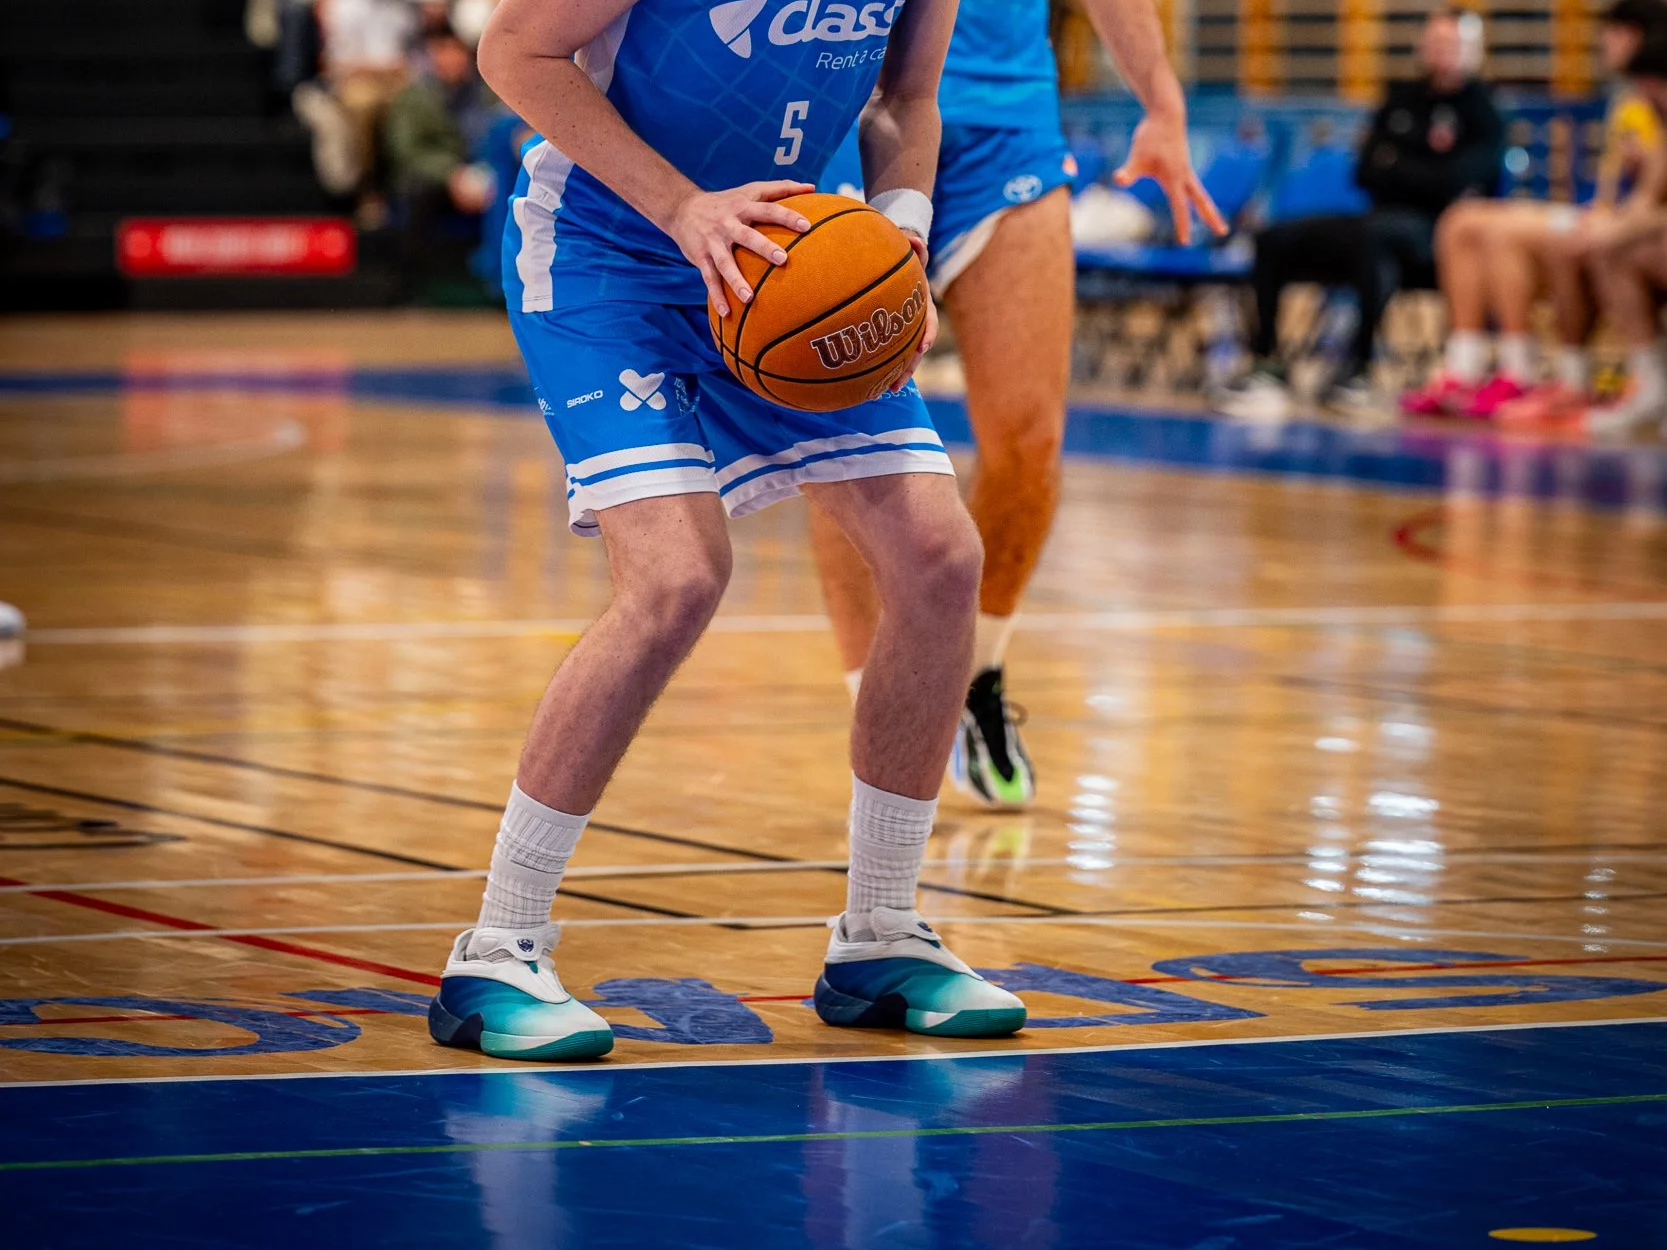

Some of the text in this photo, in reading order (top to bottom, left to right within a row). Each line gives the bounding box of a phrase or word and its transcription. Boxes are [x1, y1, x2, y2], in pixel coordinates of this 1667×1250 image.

[815, 46, 888, 70] Rent a ca
[774, 100, 809, 166] 5
[566, 389, 604, 409] SIROKO
